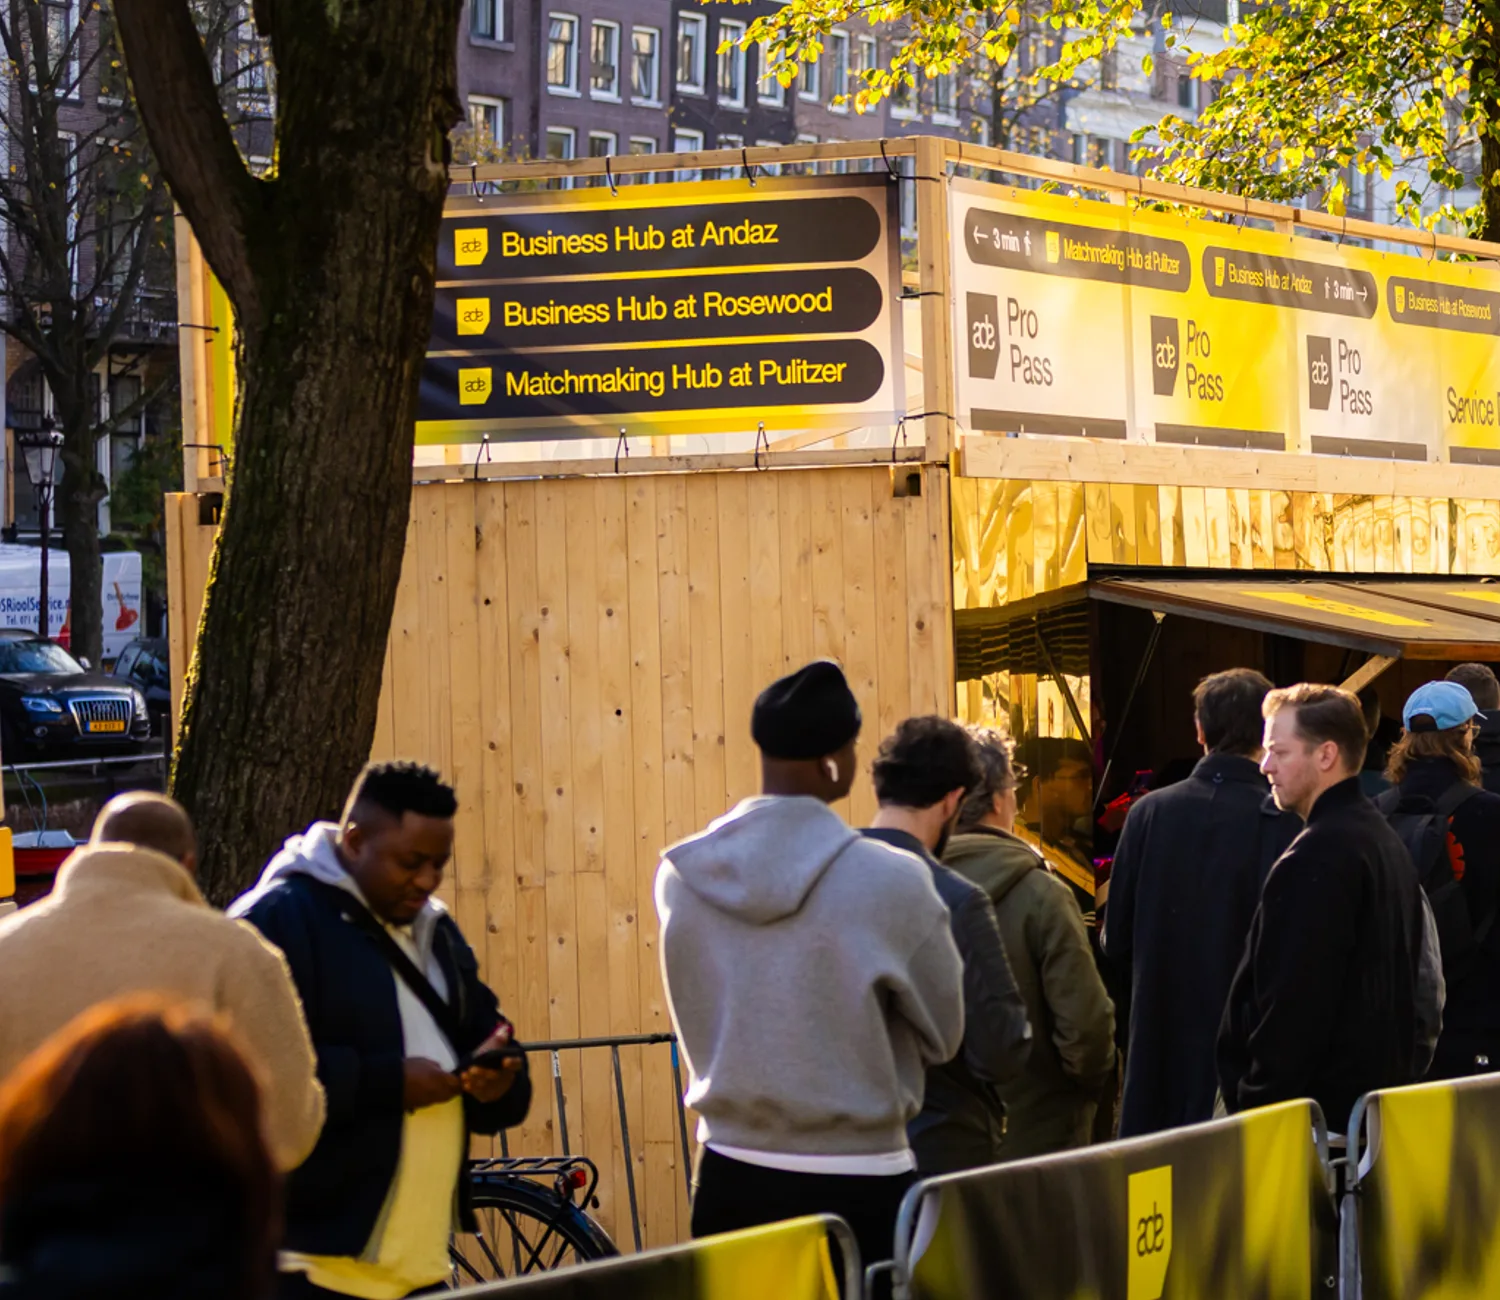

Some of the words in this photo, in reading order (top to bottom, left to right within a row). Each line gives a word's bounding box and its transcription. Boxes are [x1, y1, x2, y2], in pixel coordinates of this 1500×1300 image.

[502, 230, 608, 257] Business
[614, 226, 665, 252] Hub
[672, 224, 695, 248] at
[701, 220, 779, 247] Andaz
[993, 232, 1001, 250] 3
[1002, 233, 1020, 252] min
[1064, 238, 1125, 271] Matchmaking
[1126, 246, 1143, 269] Hub
[1144, 252, 1152, 270] at
[1153, 250, 1180, 274] Pulitzer
[1229, 263, 1264, 288] Business
[1265, 269, 1280, 290] Hub
[1282, 272, 1289, 291] at
[1291, 272, 1313, 294] Andaz
[1334, 280, 1340, 299] 3
[1340, 282, 1354, 300] min
[504, 300, 610, 327] Business
[616, 296, 667, 322] Hub
[674, 294, 697, 319] at
[704, 286, 832, 317] Rosewood
[1007, 297, 1038, 339] Pro
[1408, 291, 1438, 313] Business
[1440, 296, 1451, 314] Hub
[1451, 299, 1459, 316] at
[1459, 298, 1492, 320] Rosewood
[972, 314, 996, 350] ade
[1187, 319, 1210, 358] Pro
[1010, 344, 1054, 386] Pass
[1156, 336, 1176, 370] ade
[1311, 354, 1329, 386] ade
[1338, 338, 1362, 376] Pro
[506, 366, 664, 398] Matchmaking
[672, 364, 722, 390] Hub
[729, 362, 753, 387] at
[760, 360, 847, 386] Pulitzer
[1186, 364, 1224, 402] Pass
[1340, 379, 1373, 417] Pass
[1448, 386, 1494, 426] Service
[1136, 1200, 1164, 1258] ade
